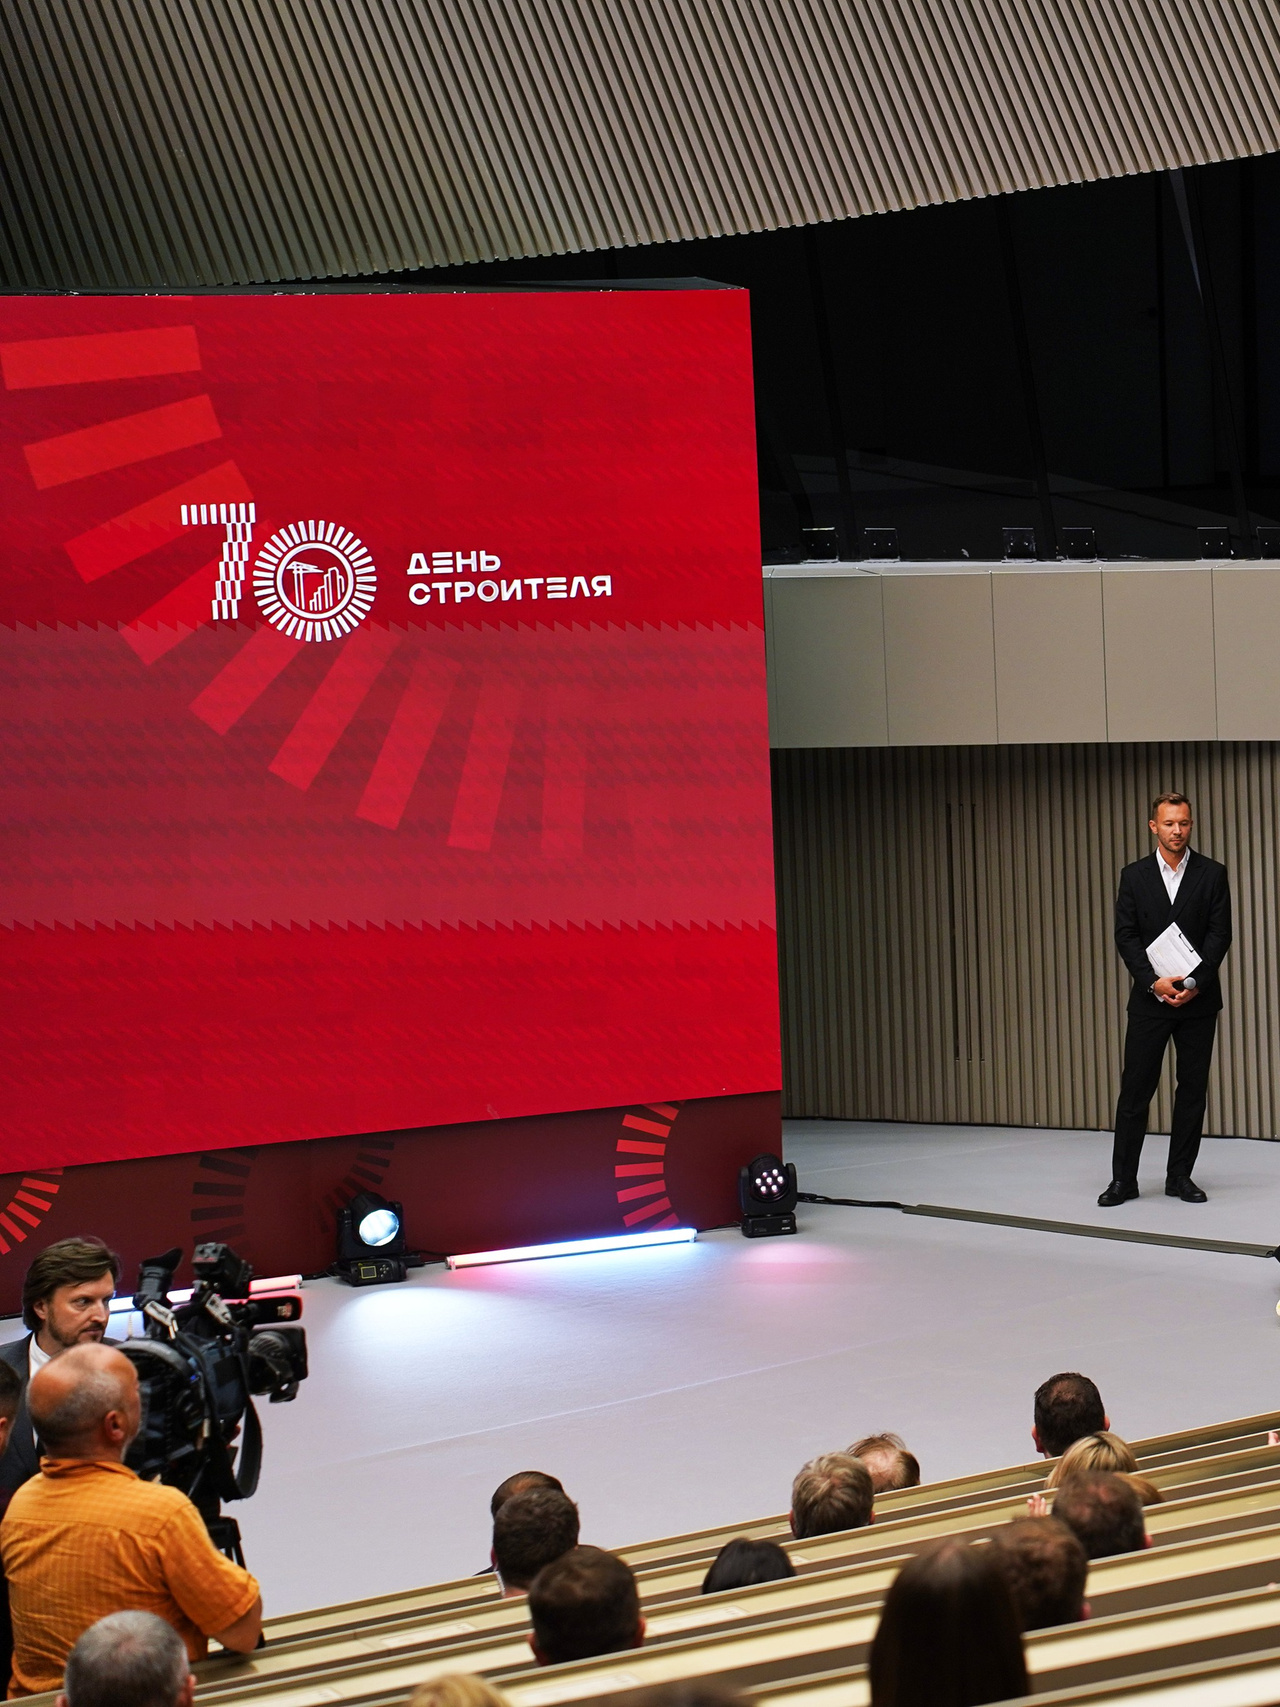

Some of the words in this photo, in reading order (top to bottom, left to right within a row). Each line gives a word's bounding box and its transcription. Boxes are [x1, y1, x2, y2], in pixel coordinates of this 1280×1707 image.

[180, 502, 377, 643] 70
[406, 550, 501, 575] ДЕНЬ
[408, 575, 612, 606] СТРОИТЕЛЯ
